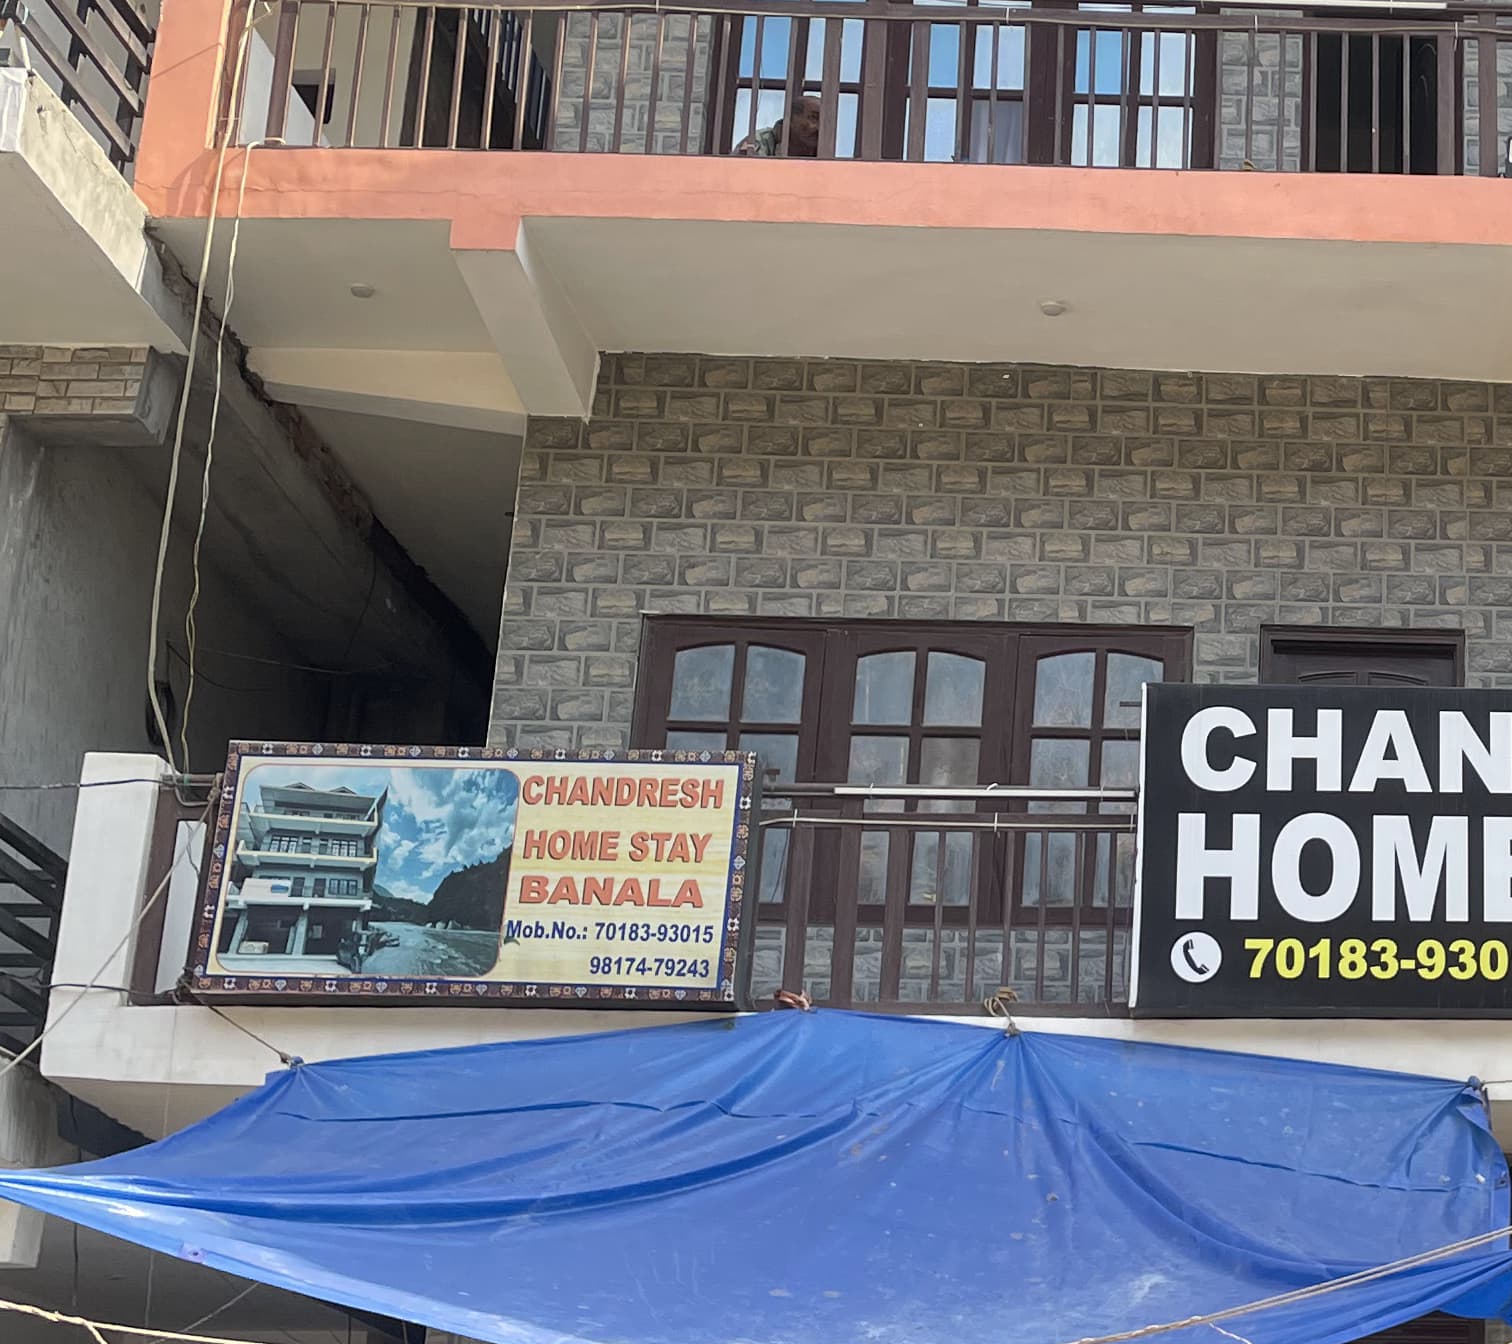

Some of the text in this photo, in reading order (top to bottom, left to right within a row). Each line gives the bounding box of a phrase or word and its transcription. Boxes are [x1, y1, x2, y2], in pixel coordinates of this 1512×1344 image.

[522, 775, 724, 809] CHANDRESH
[523, 830, 713, 863] HOME STAY
[518, 875, 704, 908] BANALA
[594, 922, 715, 944] 70183-93015
[589, 956, 710, 979] 98174-79243
